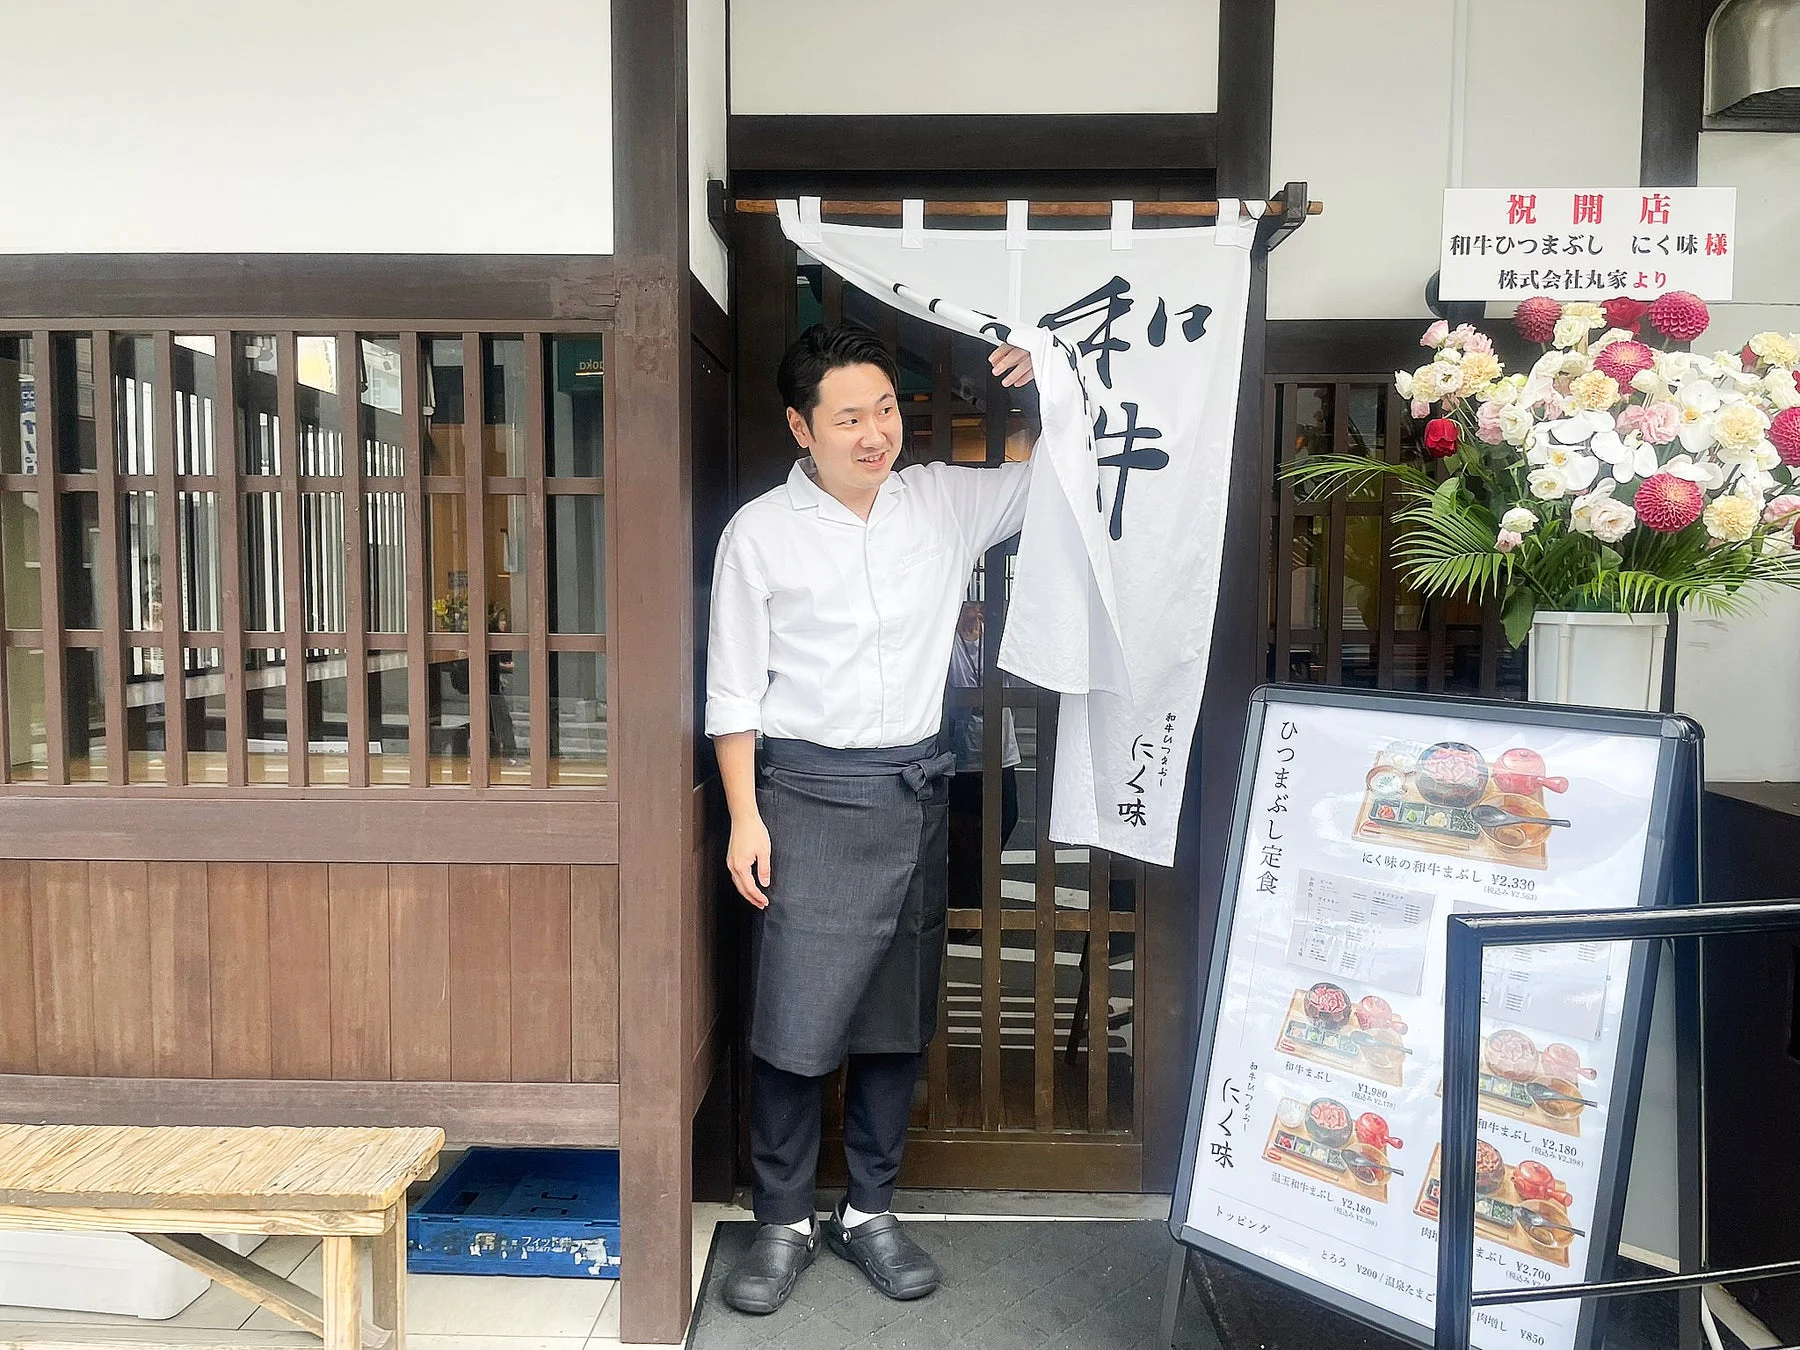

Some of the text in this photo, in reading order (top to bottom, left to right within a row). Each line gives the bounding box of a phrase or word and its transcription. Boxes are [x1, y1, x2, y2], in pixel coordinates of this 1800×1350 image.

[1449, 234, 1604, 256] 和牛ひつまぶし
[1036, 275, 1213, 541] 和牛
[1117, 733, 1155, 828] にく味
[1256, 721, 1299, 895] ひつまぶし定食
[1361, 852, 1483, 883] にく味の和牛まぶし
[1285, 1061, 1333, 1083] 和牛まぶし
[1210, 1077, 1240, 1169] にく味
[1542, 1138, 1578, 1157] ¥2,180
[1341, 1197, 1372, 1215] ¥2,180
[1216, 1205, 1271, 1234] トッピング
[1321, 1249, 1347, 1268] とろろ
[1516, 1261, 1551, 1282] ¥2,700
